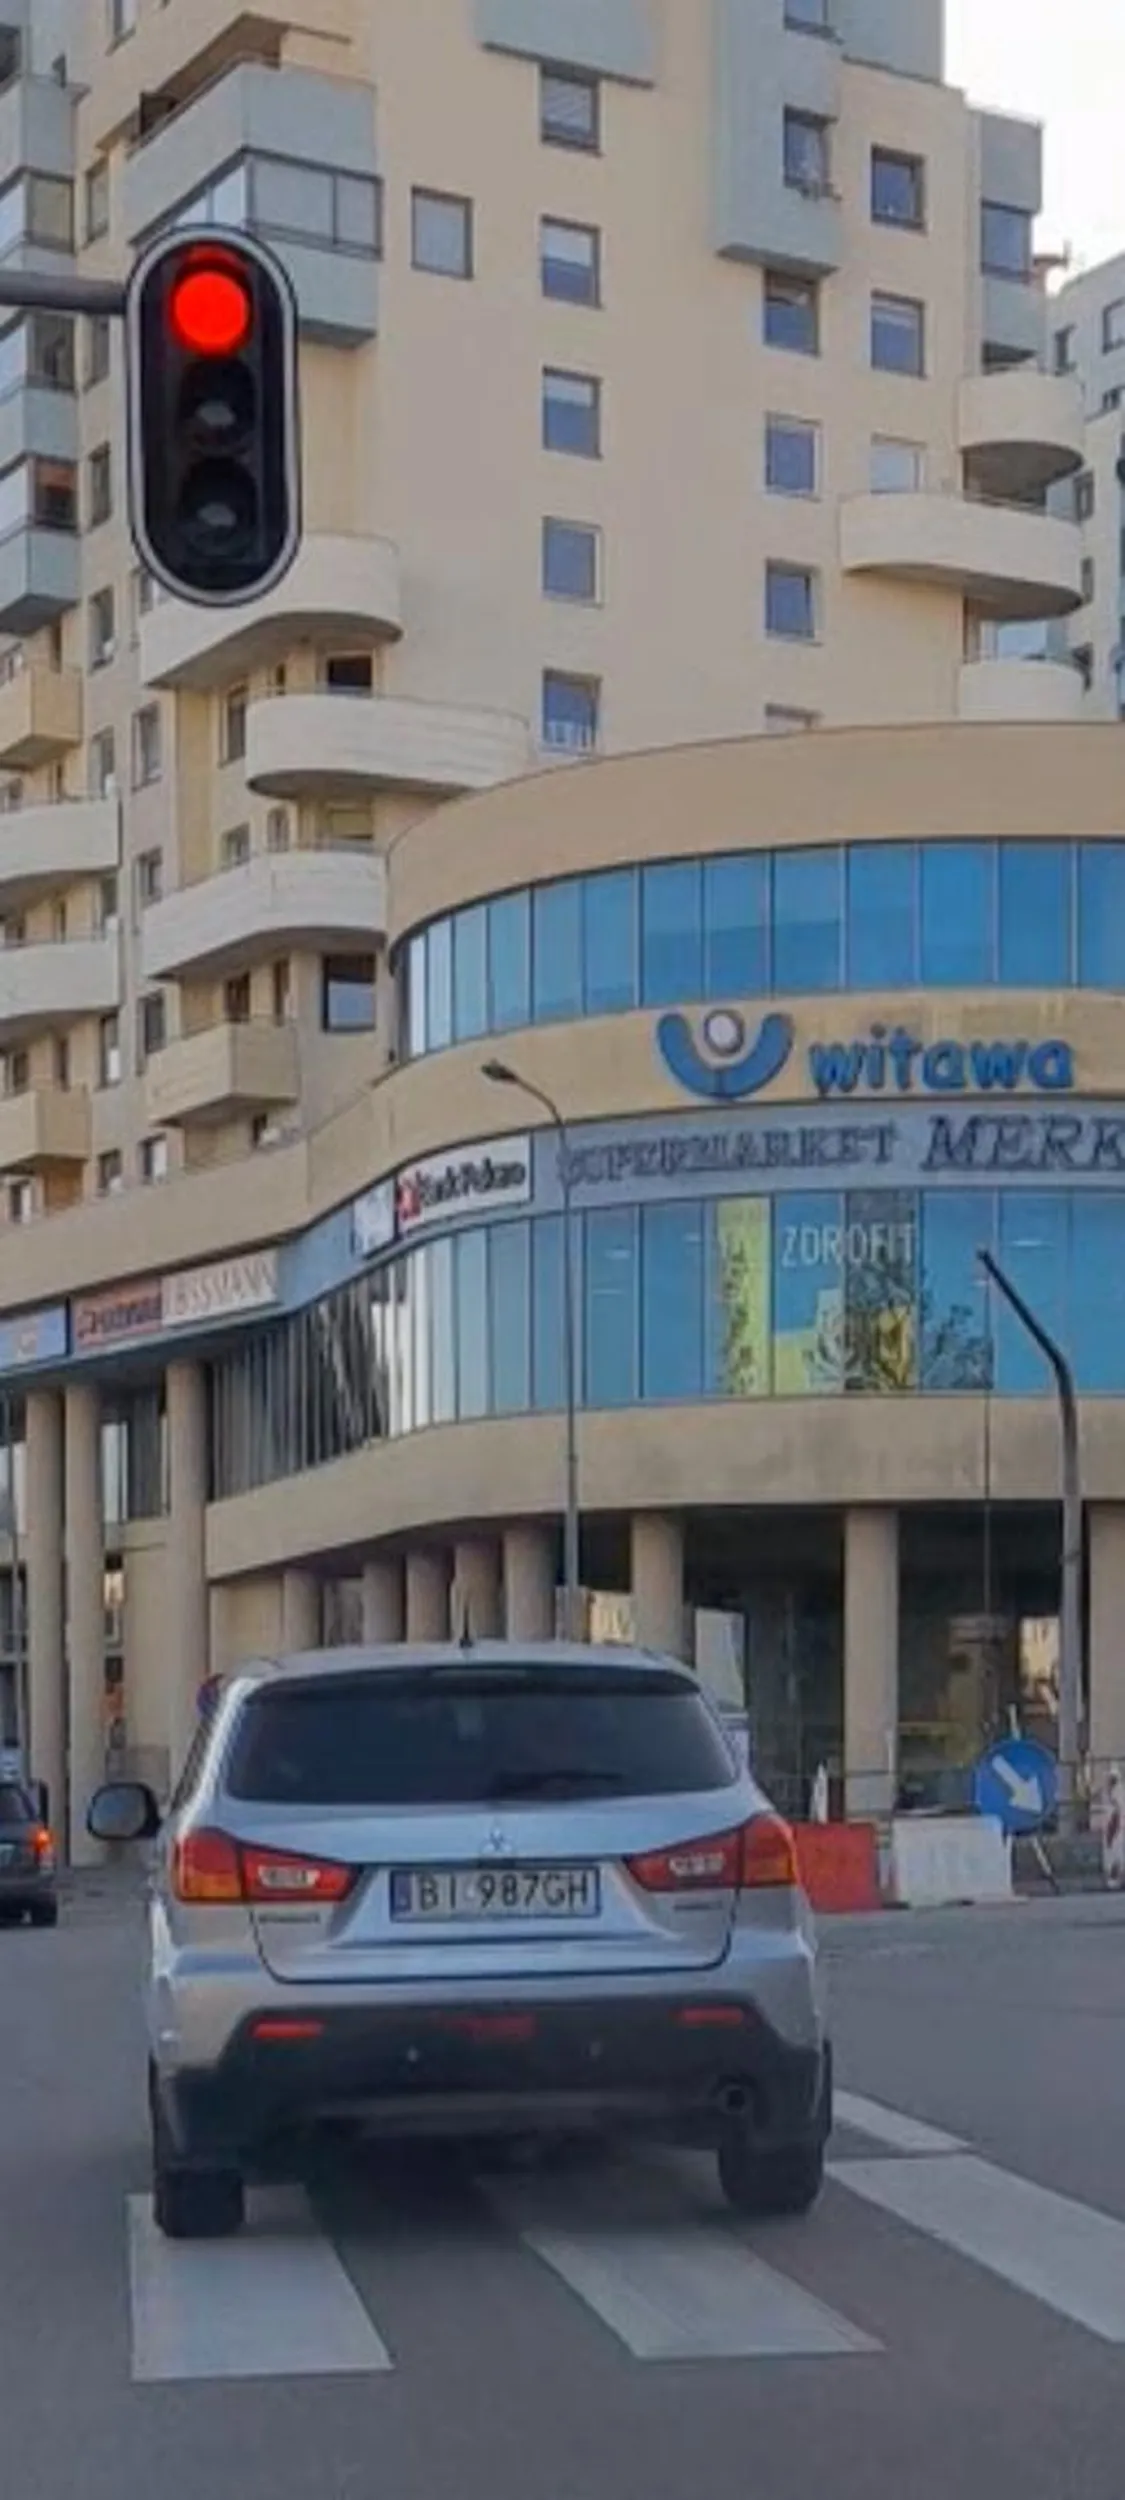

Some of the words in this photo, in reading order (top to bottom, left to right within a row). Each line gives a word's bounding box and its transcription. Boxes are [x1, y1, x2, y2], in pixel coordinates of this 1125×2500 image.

[808, 1023, 1074, 1098] witawa
[781, 1221, 916, 1268] ZDROFIT
[478, 1872, 588, 1909] 987GH
